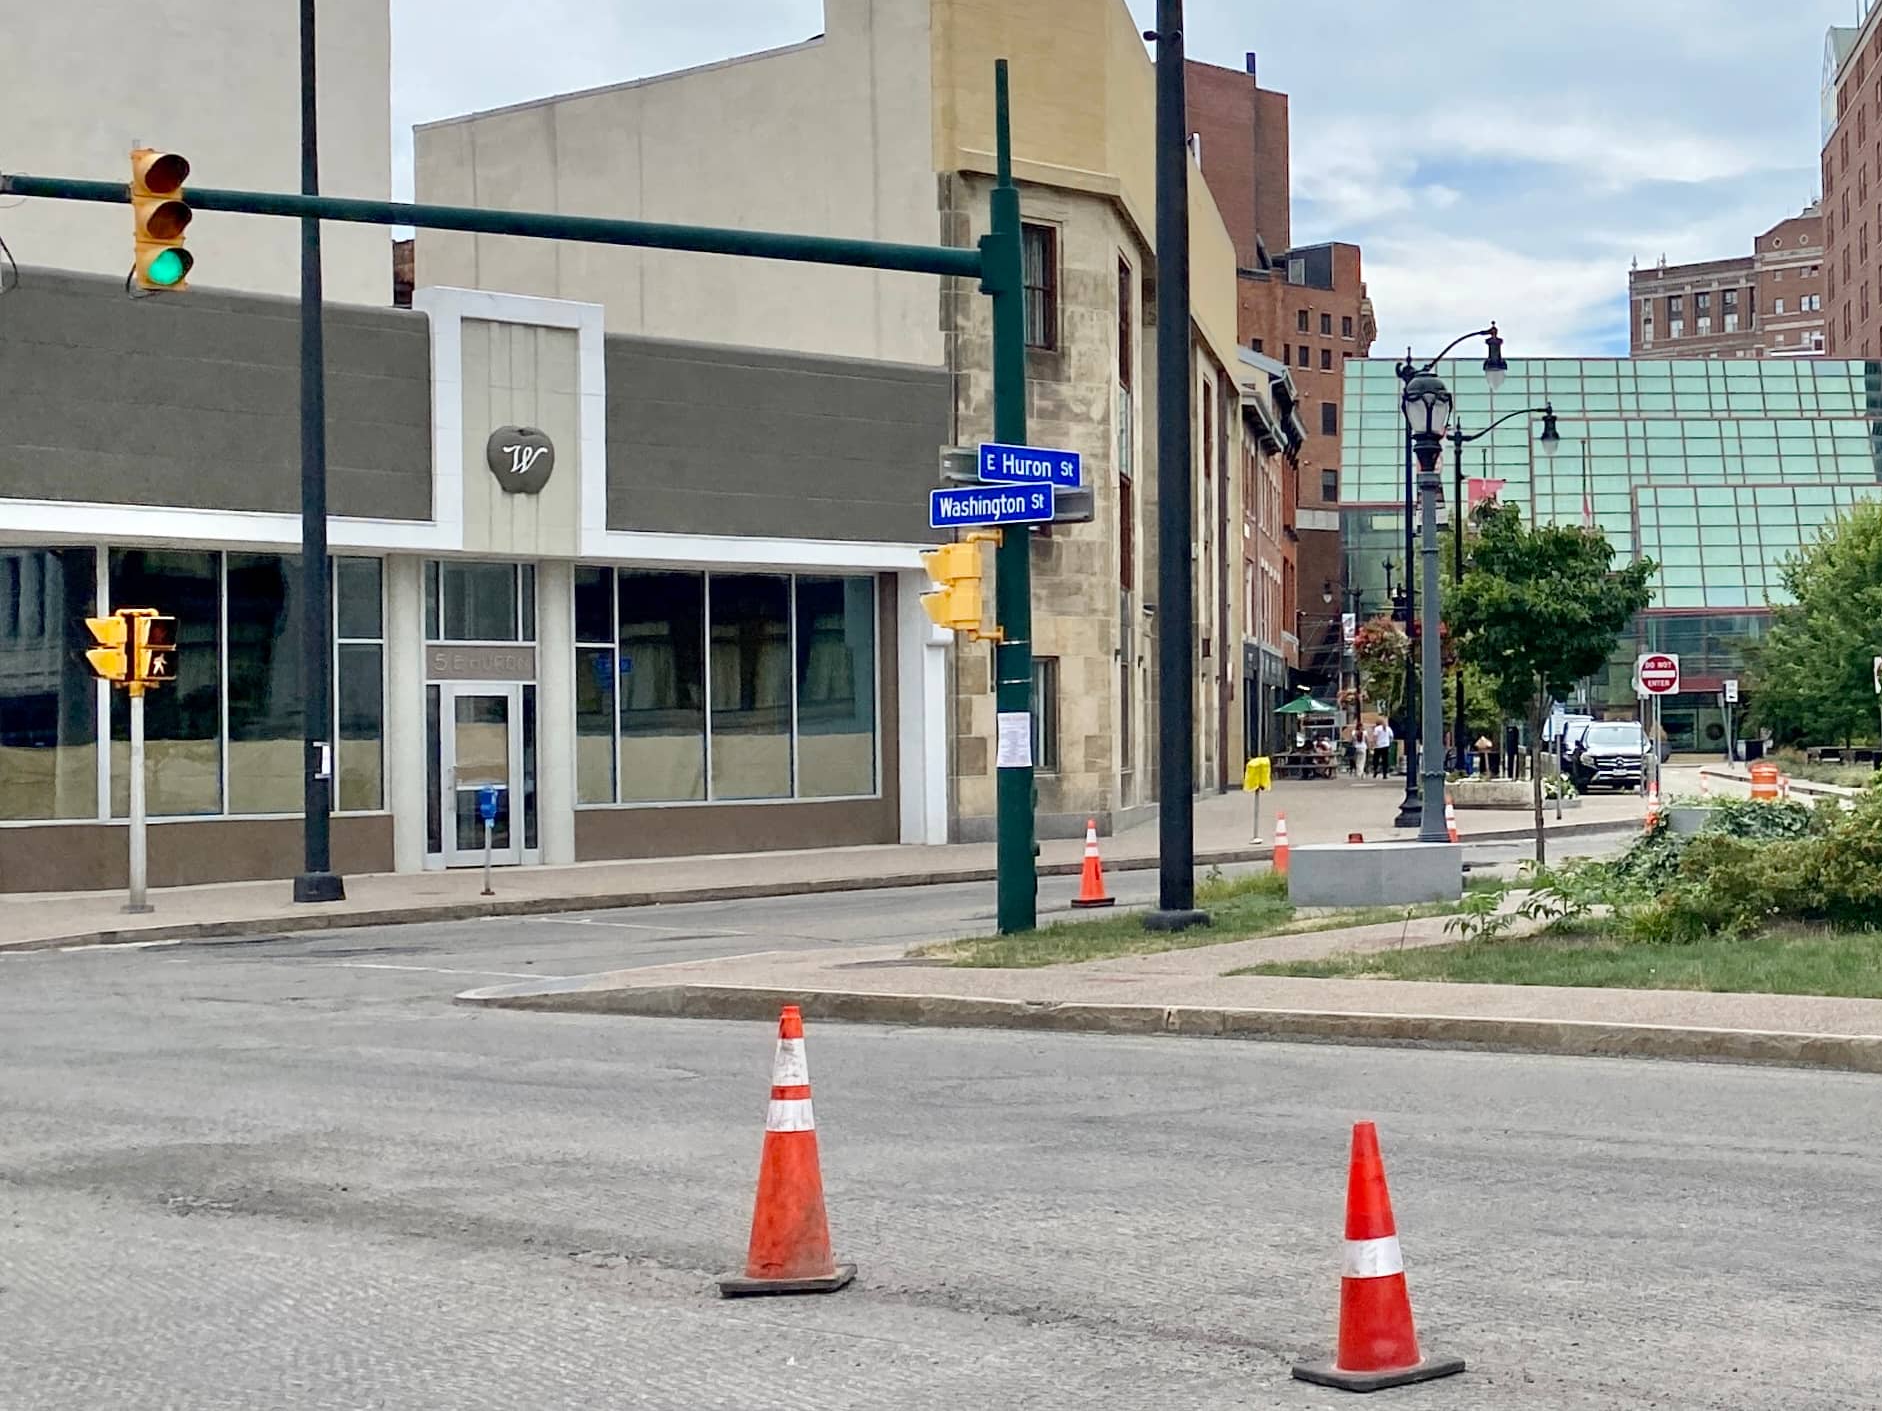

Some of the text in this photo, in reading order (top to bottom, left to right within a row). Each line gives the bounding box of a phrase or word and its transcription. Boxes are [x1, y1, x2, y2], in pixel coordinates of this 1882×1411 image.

[502, 445, 549, 474] W
[987, 453, 1074, 478] E Huron St
[939, 493, 1045, 521] Washington St
[1645, 661, 1672, 669] DO NOT
